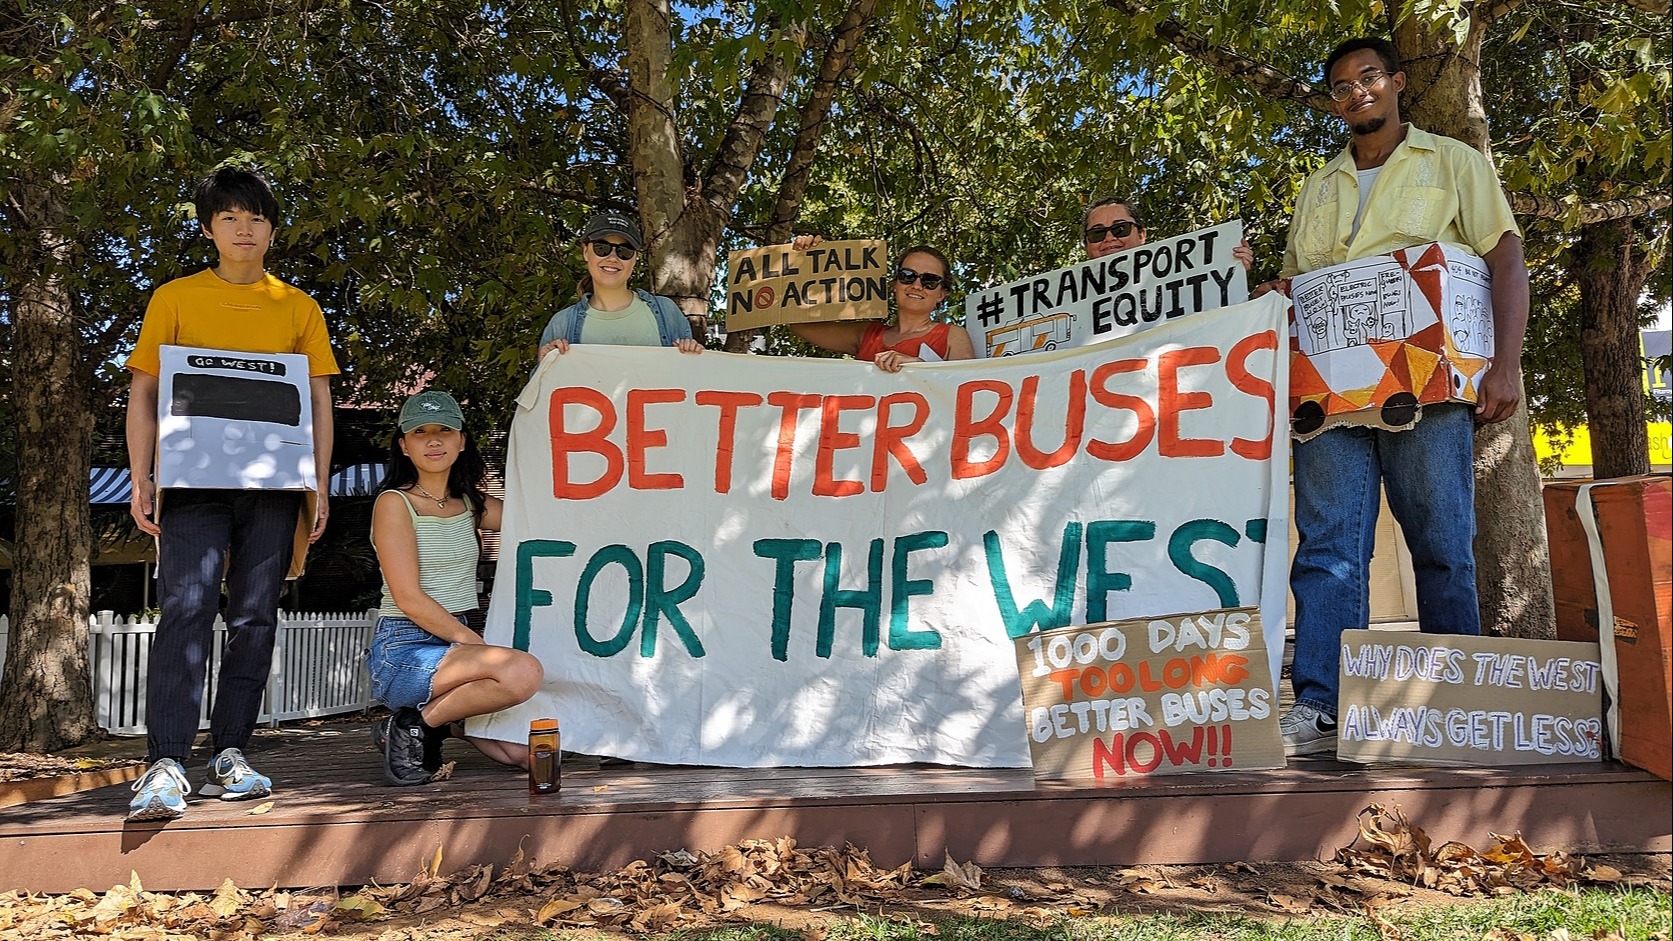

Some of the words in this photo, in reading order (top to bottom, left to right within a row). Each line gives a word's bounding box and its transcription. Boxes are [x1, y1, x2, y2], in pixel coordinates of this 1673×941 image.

[733, 252, 799, 284] ALL
[806, 247, 880, 273] TALK
[1340, 282, 1372, 292] ELECTRIC
[731, 286, 775, 315] NO
[781, 277, 887, 308] ACTION
[1092, 266, 1236, 335] EQUITY
[221, 359, 275, 373] WEST!
[548, 386, 930, 500] BETTER
[951, 329, 1278, 480] BUSES
[513, 539, 706, 659] FOR
[753, 531, 948, 662] THE
[983, 518, 1267, 639] WES
[1027, 628, 1127, 678] 1000
[1147, 612, 1251, 654] DAYS
[1342, 643, 1393, 681] WHY
[1394, 645, 1467, 684] DOES
[1472, 652, 1527, 689] THE
[1527, 655, 1602, 694] WEST
[1050, 662, 1136, 701] TOO
[1138, 653, 1250, 692] LONG
[1031, 696, 1153, 743] BETTER
[1160, 687, 1270, 727] BUSES
[1341, 704, 1443, 747] ALWAYS
[1445, 708, 1512, 751] GET
[1514, 712, 1601, 759] LESS?
[1092, 724, 1233, 779] NOW!!
